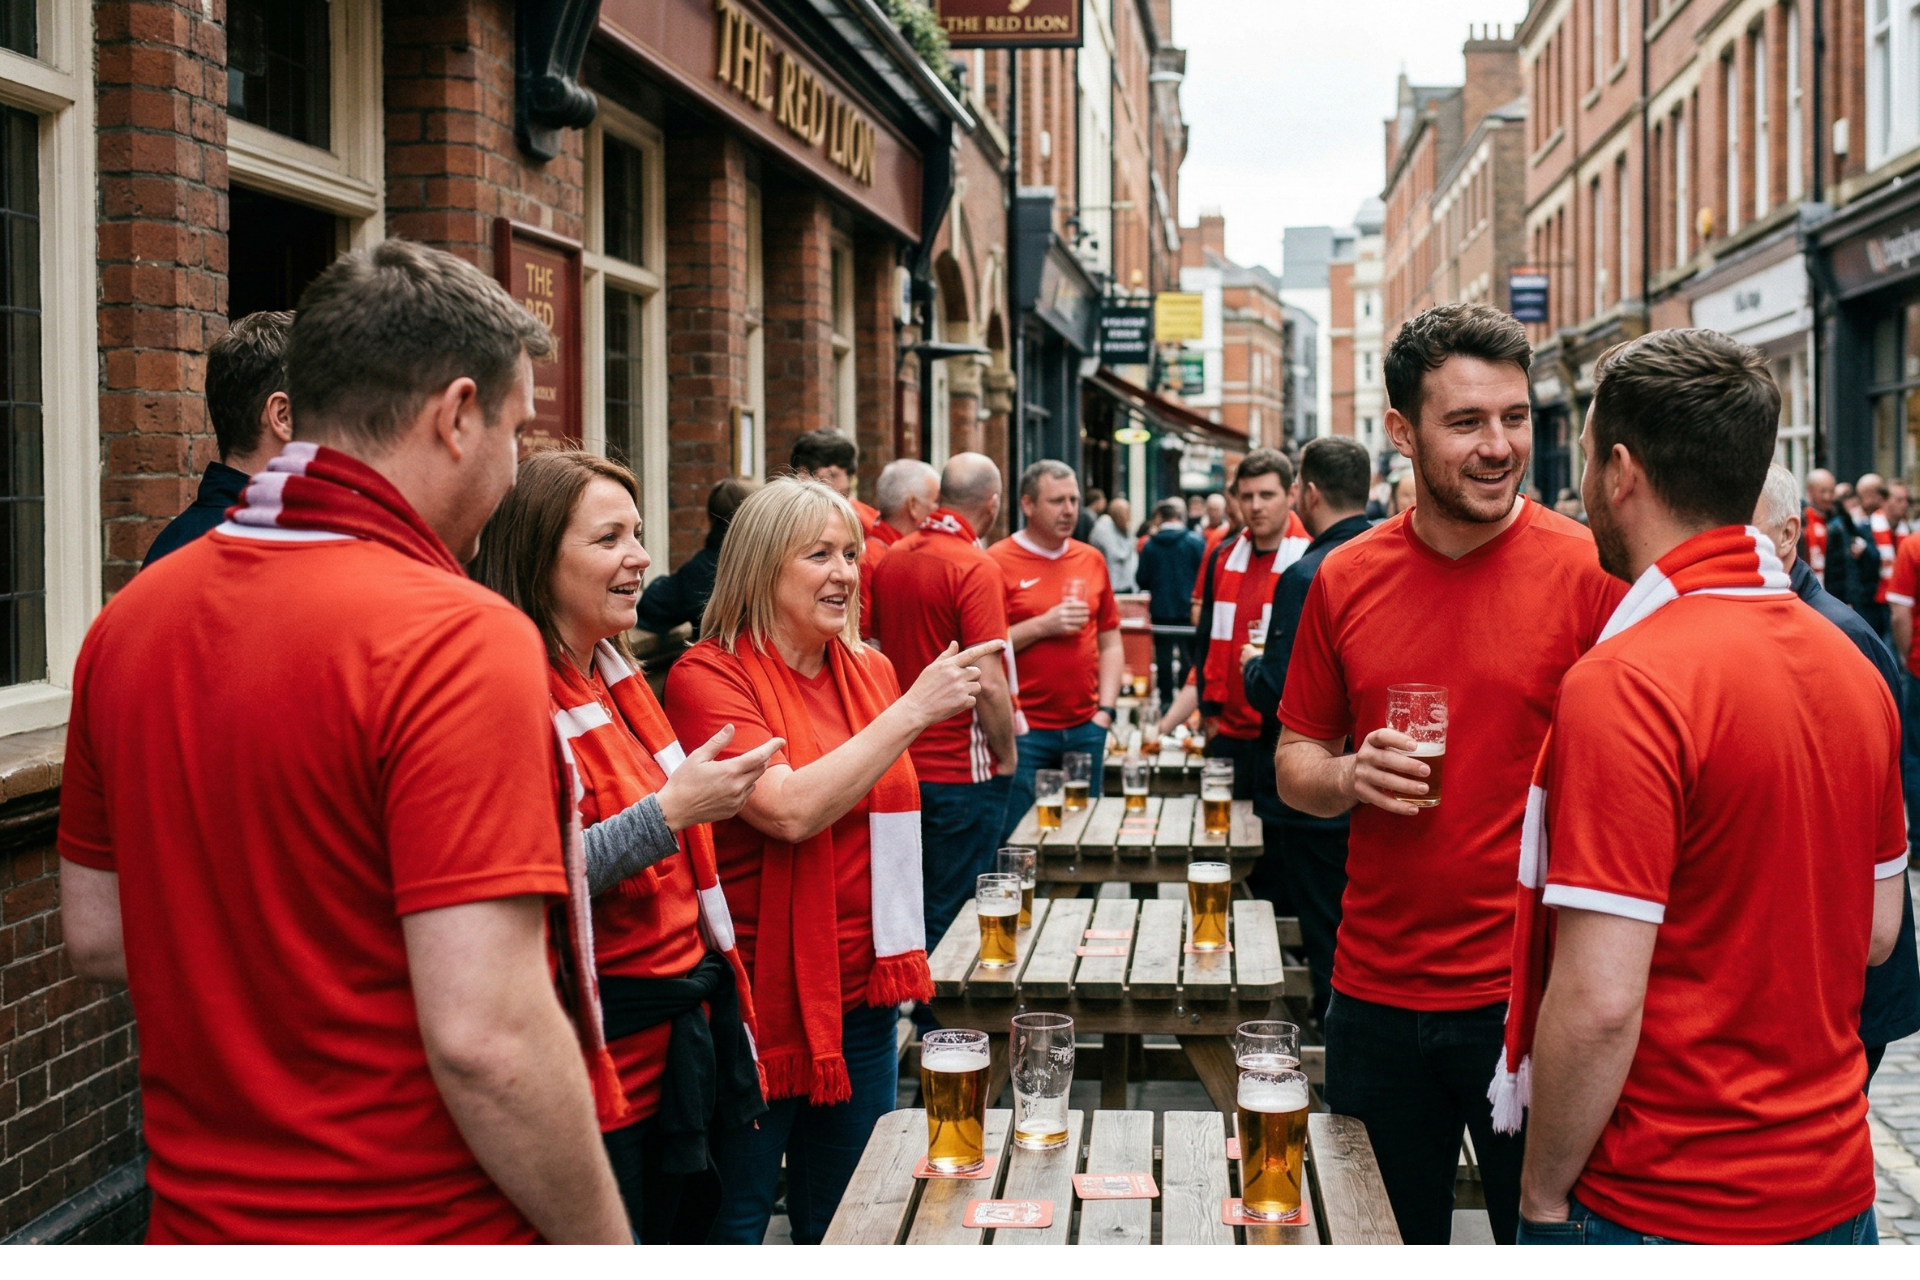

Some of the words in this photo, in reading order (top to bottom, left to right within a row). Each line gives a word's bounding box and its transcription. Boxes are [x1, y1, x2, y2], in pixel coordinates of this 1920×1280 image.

[944, 15, 981, 32] THE
[985, 15, 1021, 32] RED
[1024, 14, 1069, 32] LION
[716, 0, 774, 112] THE
[776, 51, 828, 147] RED
[828, 94, 876, 188] LION
[525, 261, 554, 298] THE
